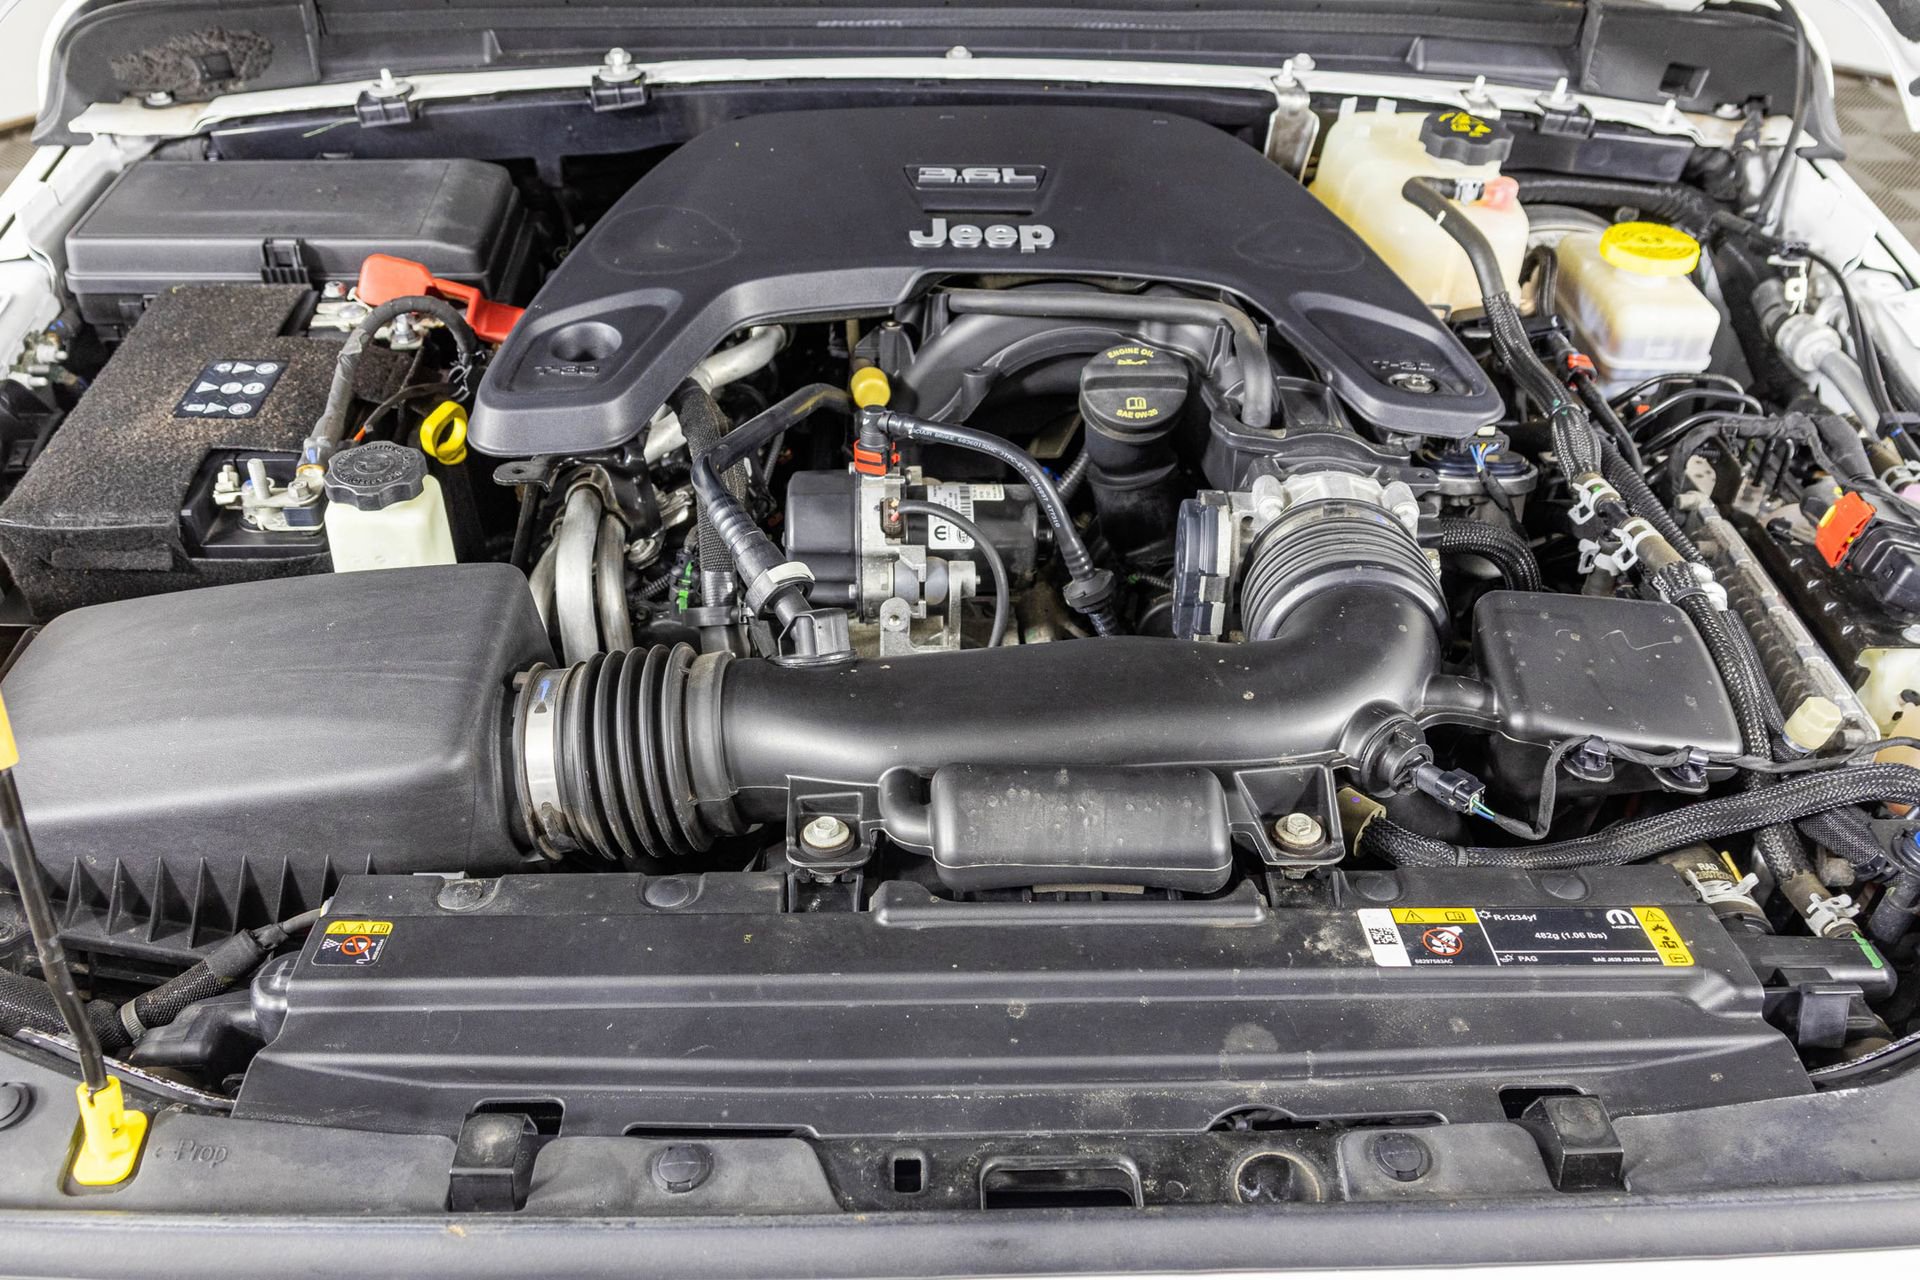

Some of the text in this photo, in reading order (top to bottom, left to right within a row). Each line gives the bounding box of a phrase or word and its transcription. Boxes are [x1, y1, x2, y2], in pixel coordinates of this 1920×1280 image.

[918, 167, 1038, 184] 3.6L
[908, 217, 1056, 253] Jeep
[1107, 347, 1155, 359] ENGINE OIL
[1116, 409, 1134, 419] SAE
[1696, 862, 1719, 871] RAD
[1493, 914, 1538, 922] R-1234yf
[1534, 932, 1560, 940] 482g
[1587, 932, 1608, 940] lbs)
[174, 1138, 229, 1168] Prop
